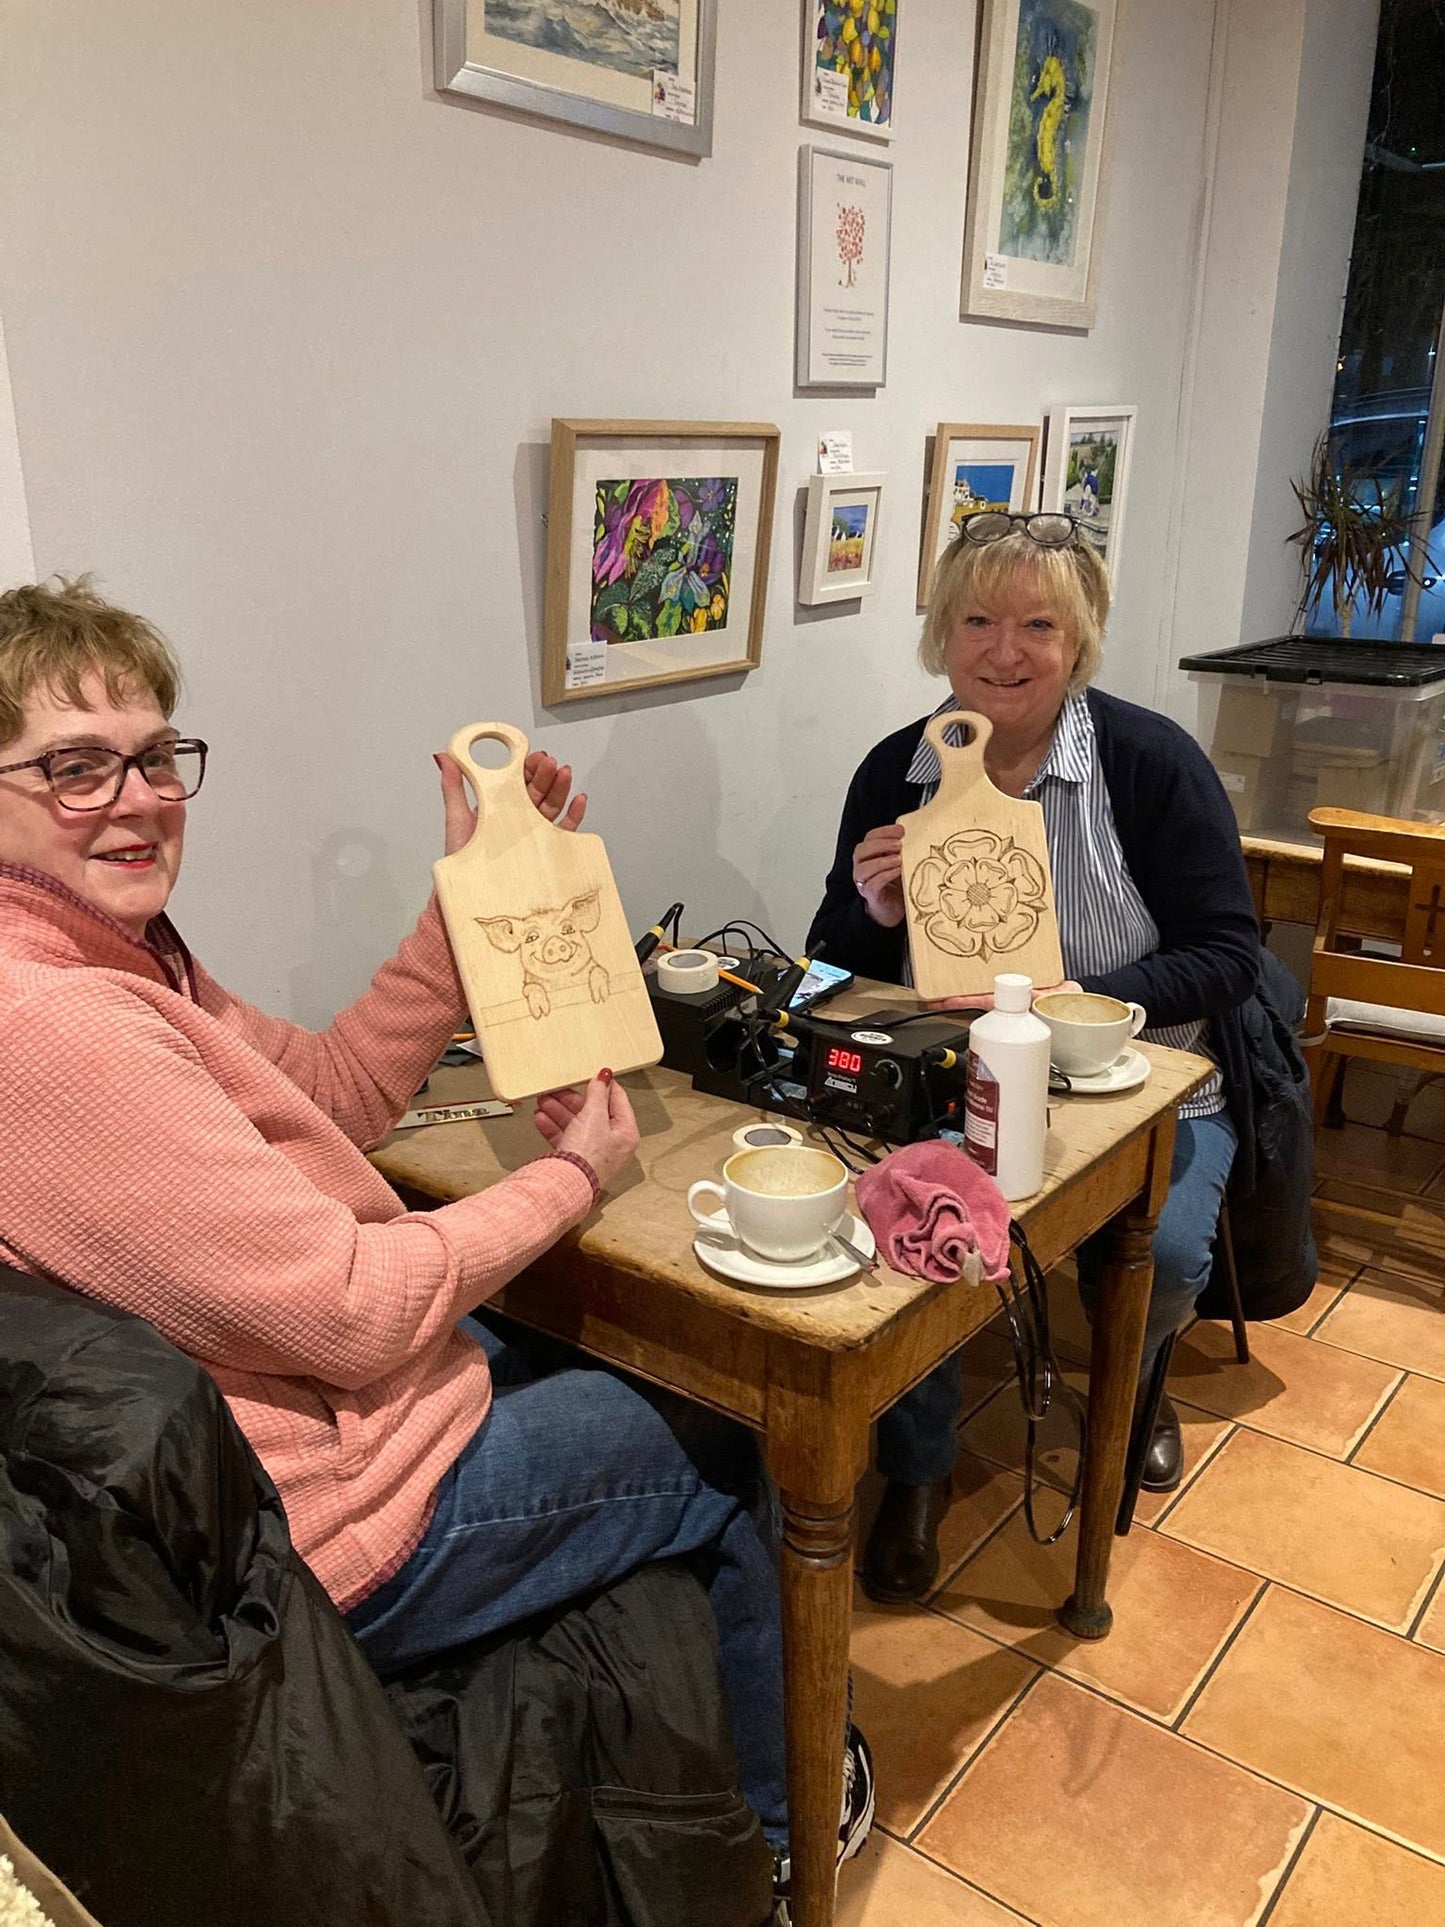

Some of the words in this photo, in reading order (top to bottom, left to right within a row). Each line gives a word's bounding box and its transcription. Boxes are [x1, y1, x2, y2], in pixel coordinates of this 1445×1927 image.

[837, 173, 845, 183] THE
[846, 175, 855, 185] ART
[855, 177, 866, 188] WALL
[828, 1048, 862, 1072] 380
